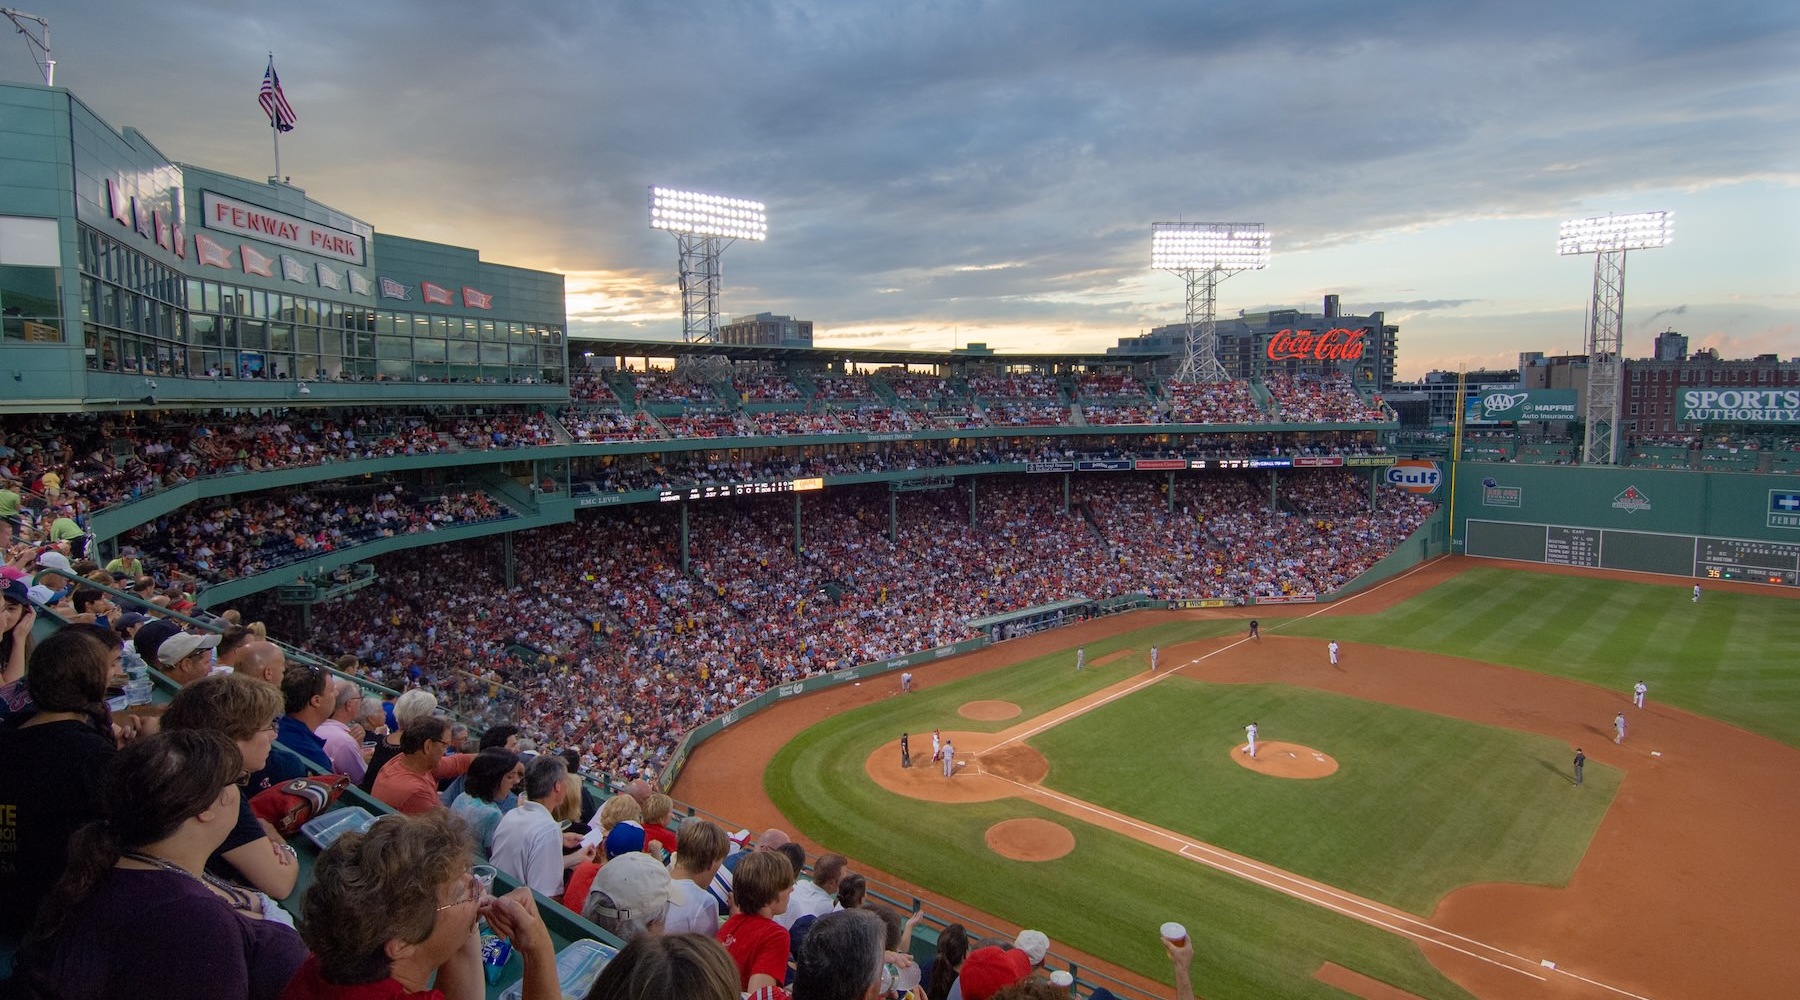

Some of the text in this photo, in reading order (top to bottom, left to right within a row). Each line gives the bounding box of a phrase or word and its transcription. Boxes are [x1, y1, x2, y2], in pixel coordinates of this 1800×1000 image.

[217, 203, 355, 256] FENWAY PARK
[1486, 394, 1511, 408] AAA
[1684, 391, 1800, 409] SPORTS
[1535, 404, 1575, 412] MAPFRE
[1389, 469, 1437, 484] Gulf
[599, 496, 621, 504] LEVEL
[1772, 516, 1800, 526] FENW
[1721, 541, 1764, 549] FENWAY
[1708, 569, 1720, 578] 35
